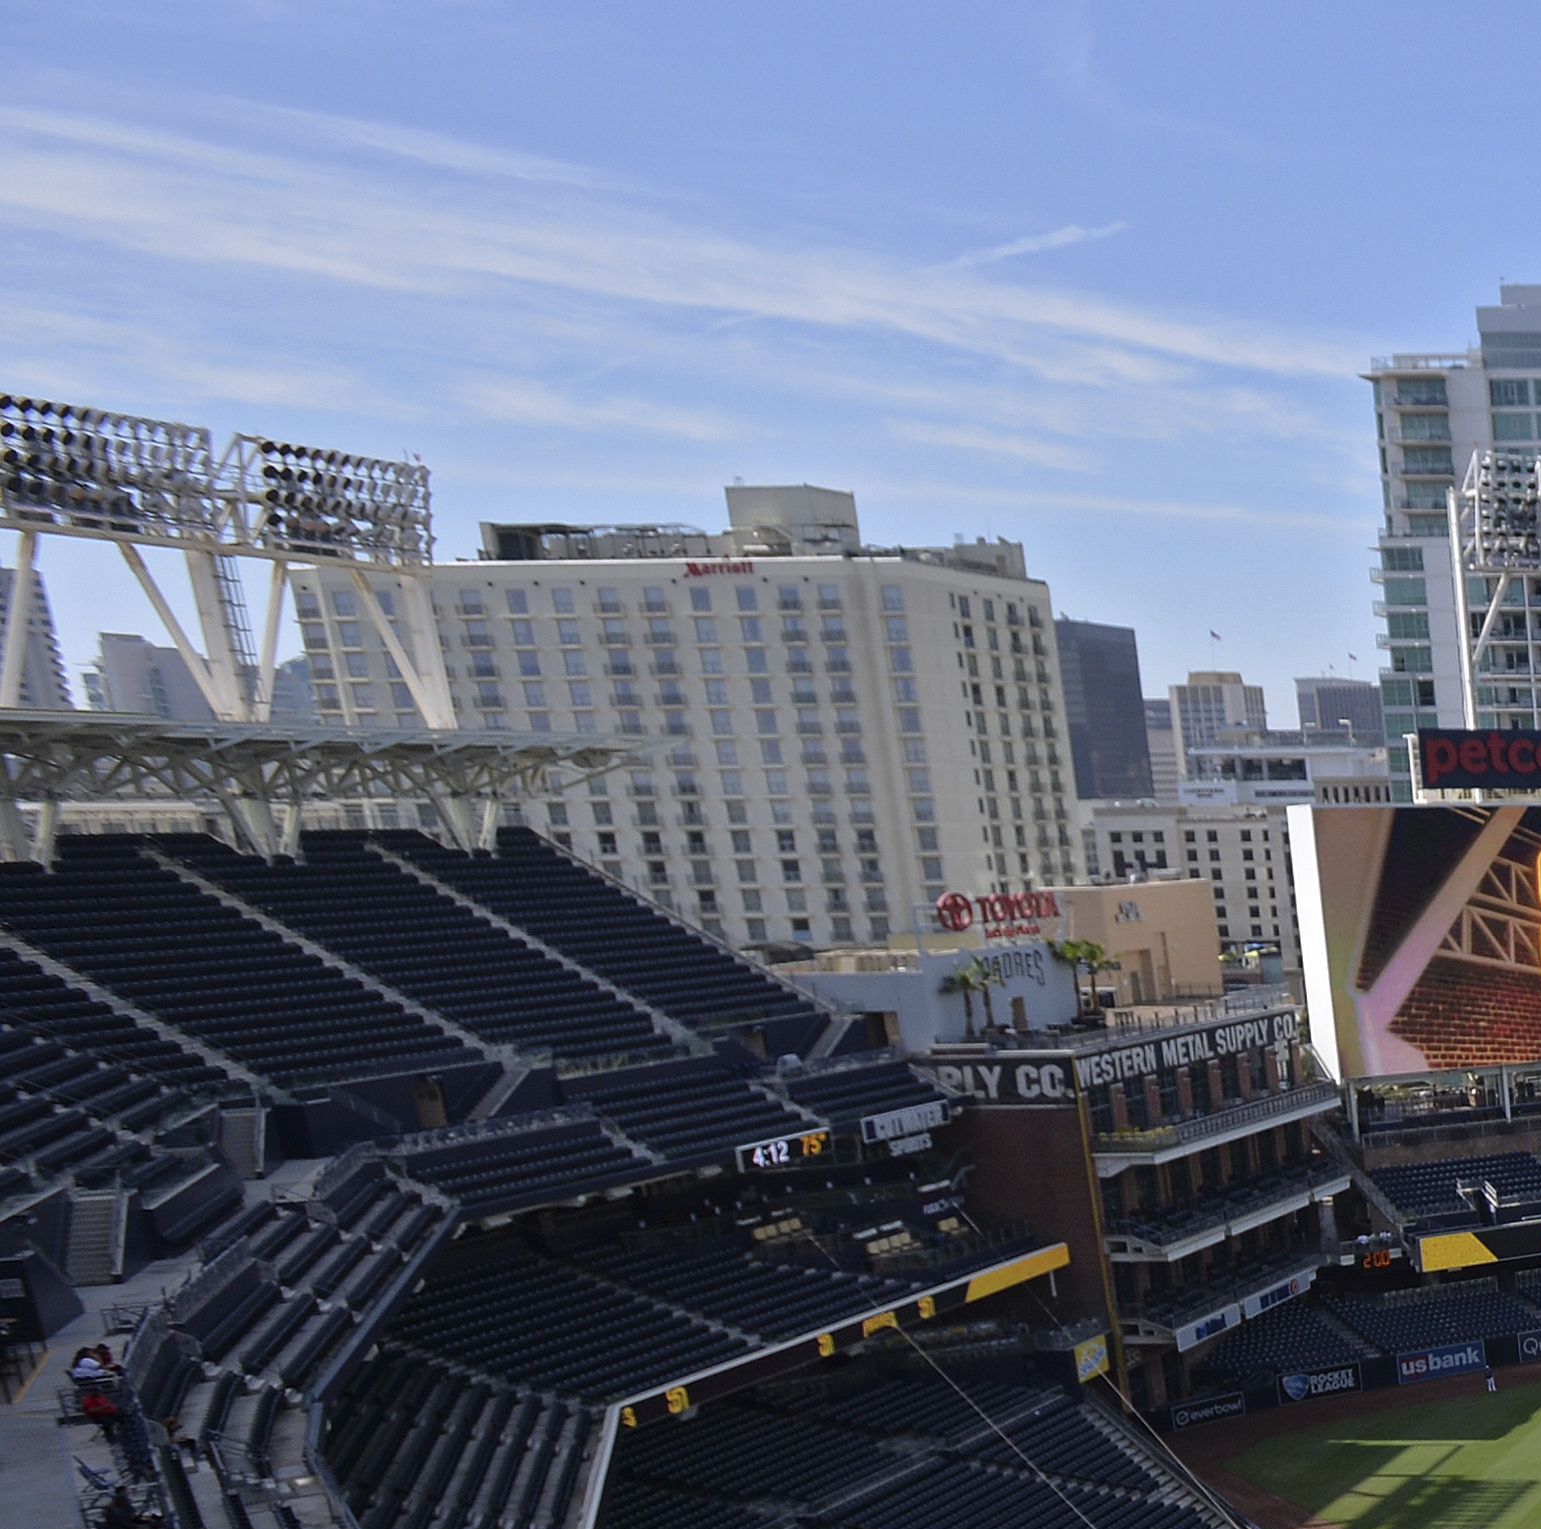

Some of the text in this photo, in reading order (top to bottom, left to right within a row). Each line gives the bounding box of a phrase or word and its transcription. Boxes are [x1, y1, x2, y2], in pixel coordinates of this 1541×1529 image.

[975, 891, 1060, 923] TOYOTA
[1076, 1045, 1158, 1088] WESTERN
[1163, 1031, 1213, 1069] METAL
[1216, 1019, 1270, 1055] SUPPLY
[752, 1140, 790, 1168] 4:12
[1310, 1368, 1353, 1386] ROCKET
[1310, 1377, 1355, 1394] LEAGUE
[1190, 1400, 1242, 1421] everbowl
